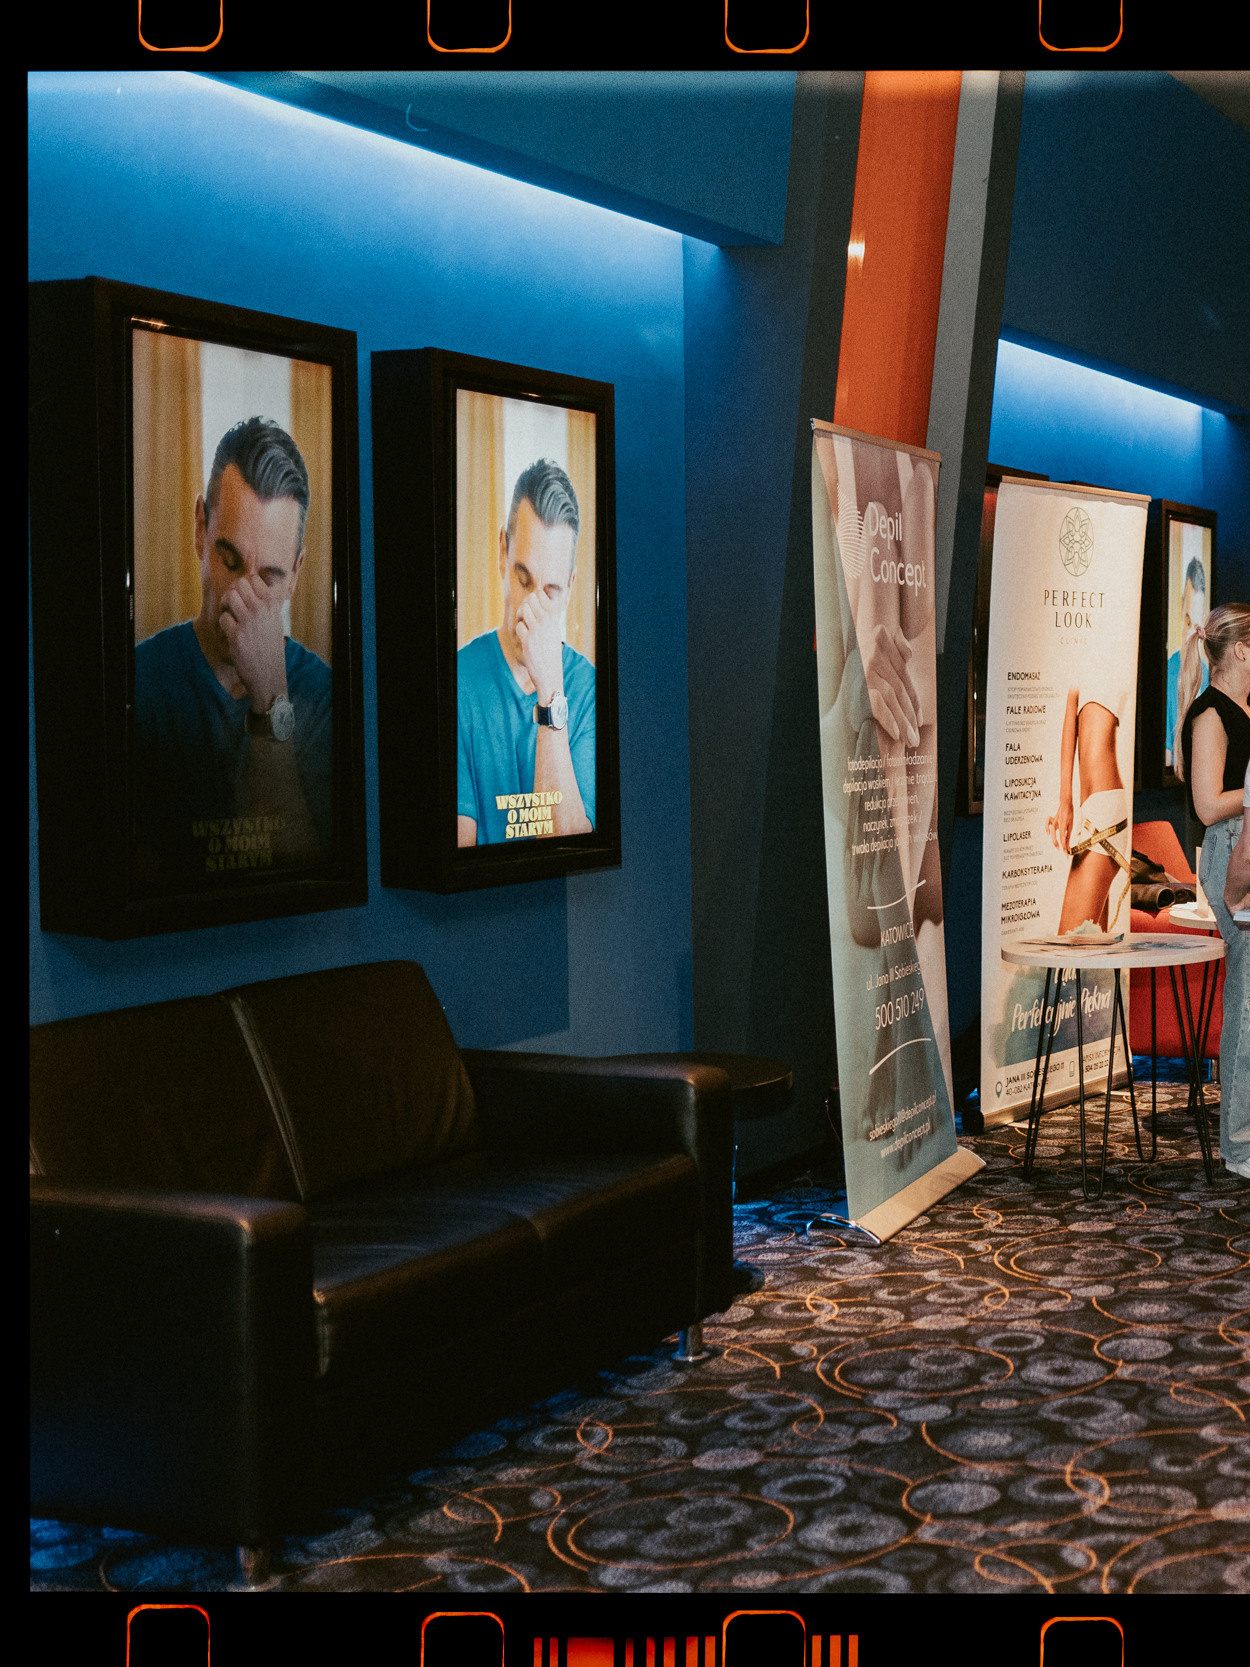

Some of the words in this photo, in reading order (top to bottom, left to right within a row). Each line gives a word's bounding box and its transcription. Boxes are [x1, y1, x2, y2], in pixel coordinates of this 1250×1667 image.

[867, 501, 902, 550] Depil
[870, 546, 927, 597] Concept
[1043, 589, 1105, 608] PERFECT
[1055, 611, 1092, 628] LOOK
[1006, 705, 1022, 715] FALE
[1022, 705, 1047, 714] RADIOWE
[1005, 743, 1021, 752] FALA
[1005, 755, 1043, 766] UDERZENIOWA
[1004, 777, 1037, 788] LIPOSUKCJA
[495, 790, 563, 810] WSZYSTKO
[1004, 790, 1042, 801] KAWITACYJNA
[507, 809, 518, 824] O
[519, 806, 552, 823] MOIM
[505, 820, 553, 839] STARYM
[1003, 830, 1032, 842] LIPOLASER
[1002, 864, 1053, 879] KARBOKSYTERAPIA
[1001, 897, 1037, 912] MEZOTERAPIA
[880, 921, 914, 947] KATOWICE
[875, 1001, 894, 1031] 500
[895, 993, 910, 1022] 510
[911, 987, 925, 1014] 249
[1005, 1075, 1020, 1088] JANA
